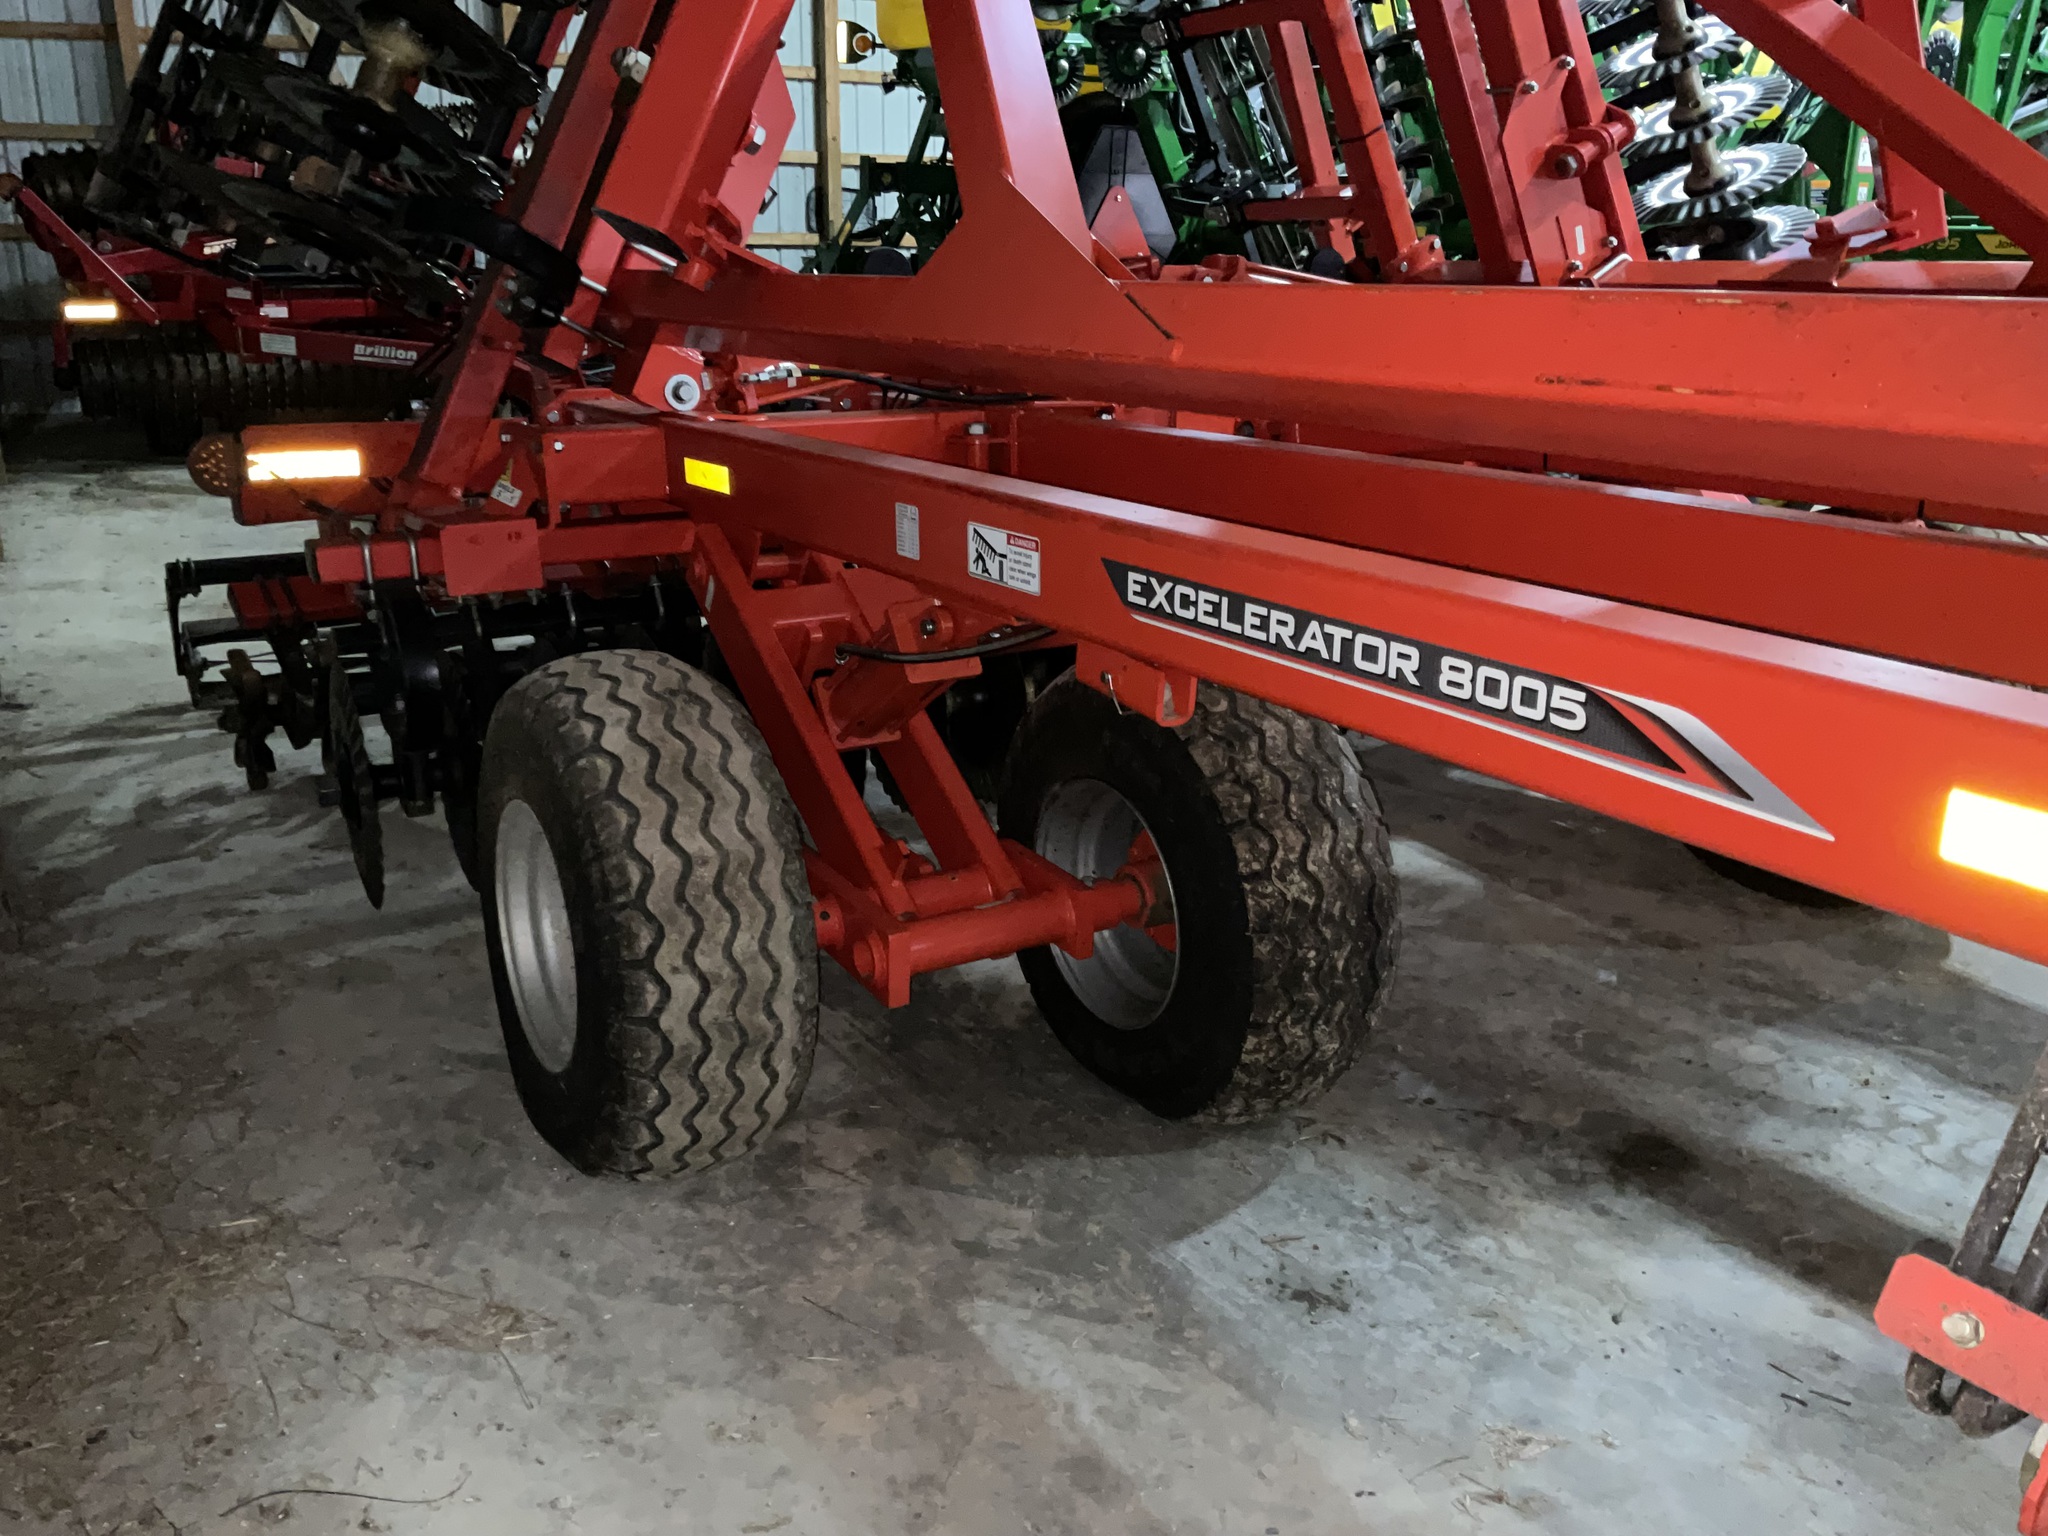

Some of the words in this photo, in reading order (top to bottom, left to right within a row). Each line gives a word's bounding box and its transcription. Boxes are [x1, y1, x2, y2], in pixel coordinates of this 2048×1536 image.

[354, 344, 418, 360] Brillion
[1127, 572, 1421, 685] EXCELERATOR
[1439, 656, 1586, 731] 8005
